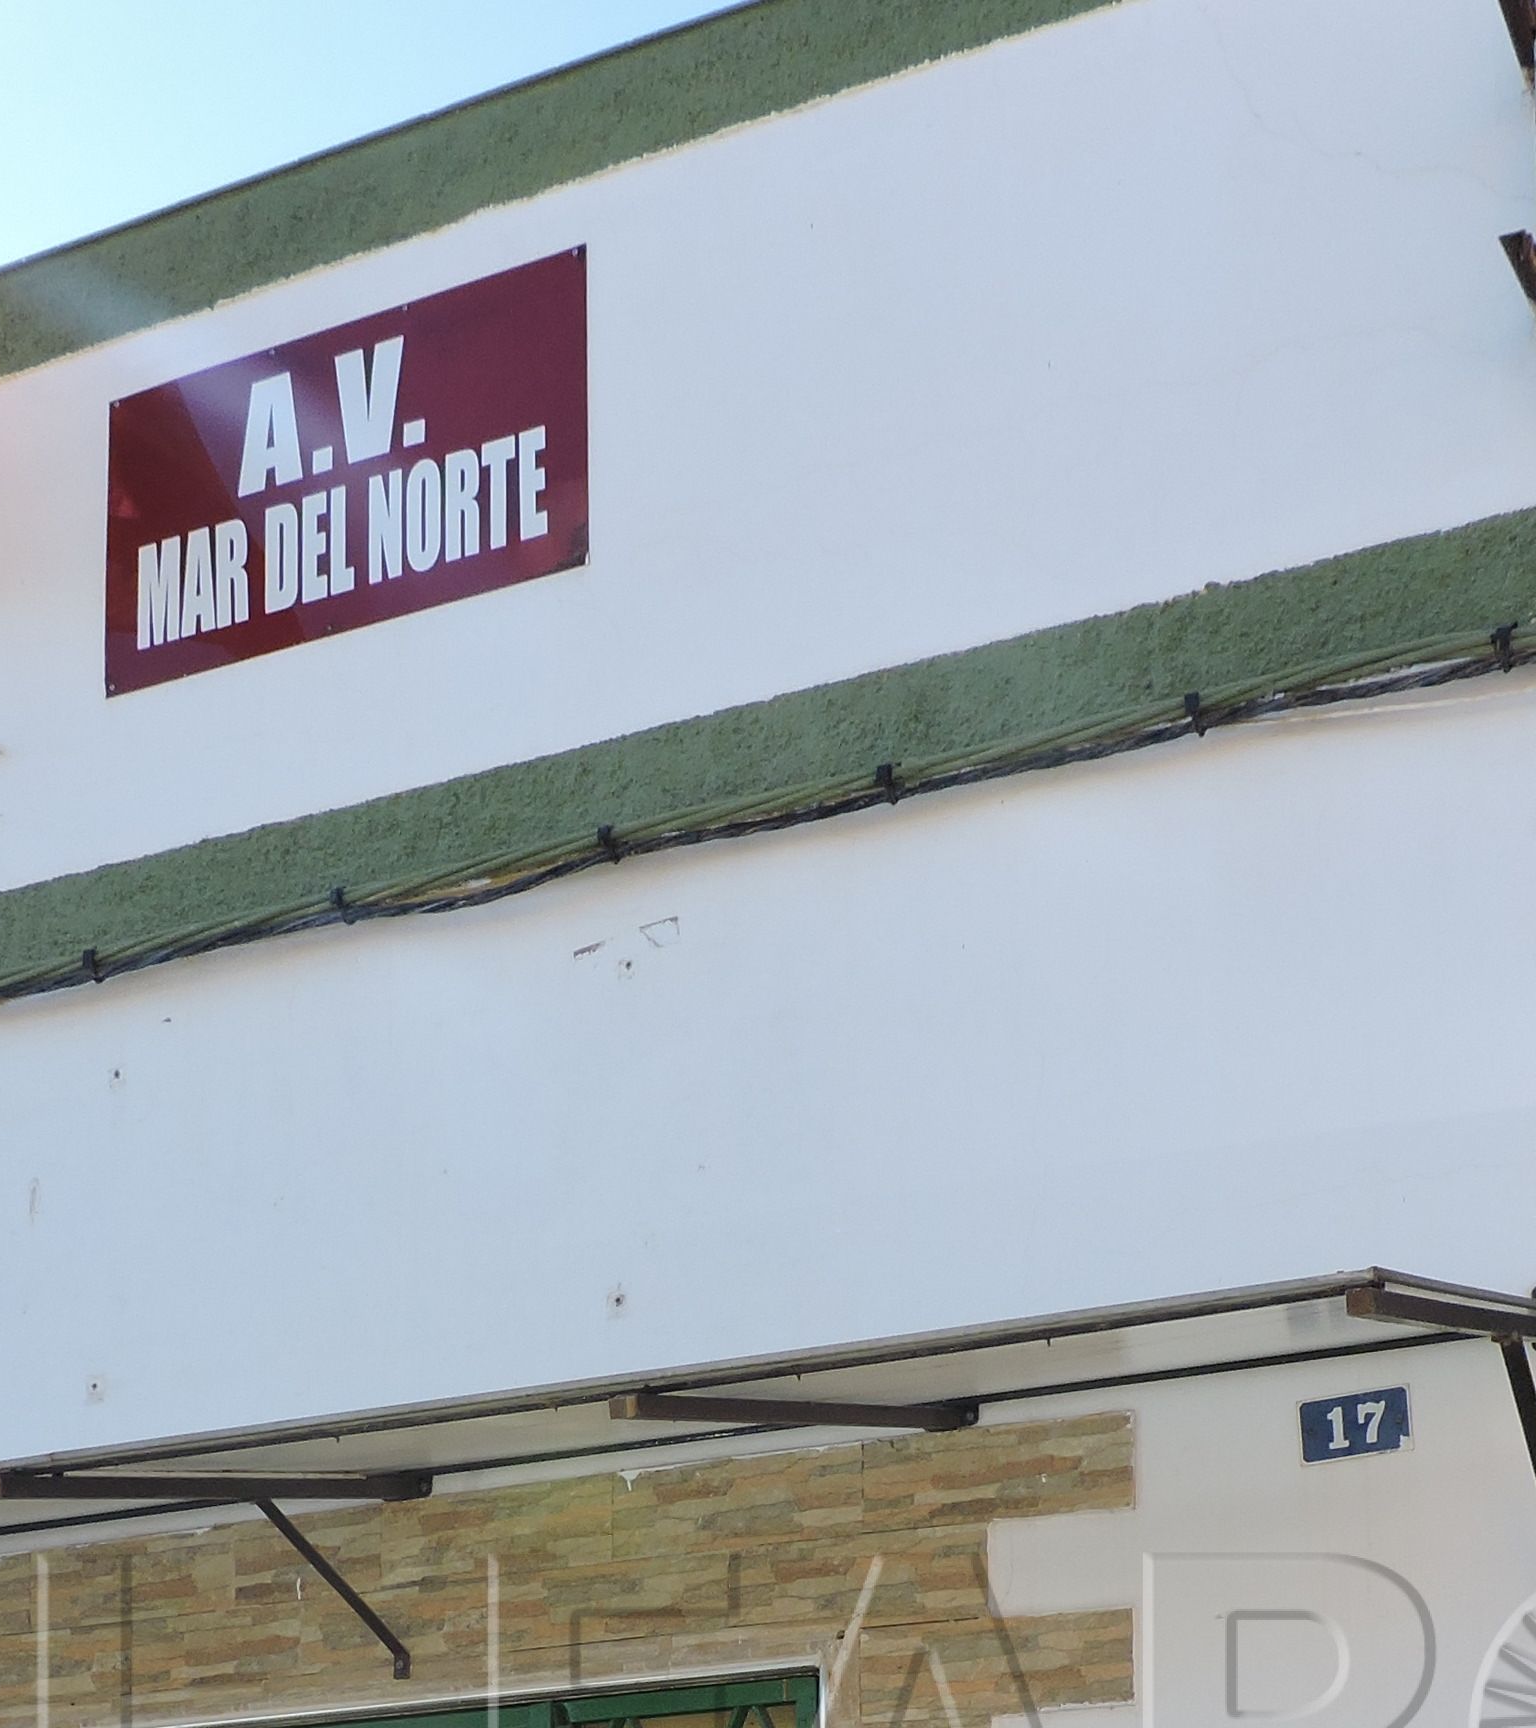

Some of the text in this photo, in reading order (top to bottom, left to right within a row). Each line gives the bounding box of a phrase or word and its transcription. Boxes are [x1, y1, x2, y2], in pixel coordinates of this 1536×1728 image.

[238, 334, 425, 498] A.V.
[137, 425, 548, 650] MAR DEL NORTE
[1327, 1400, 1386, 1450] 17
